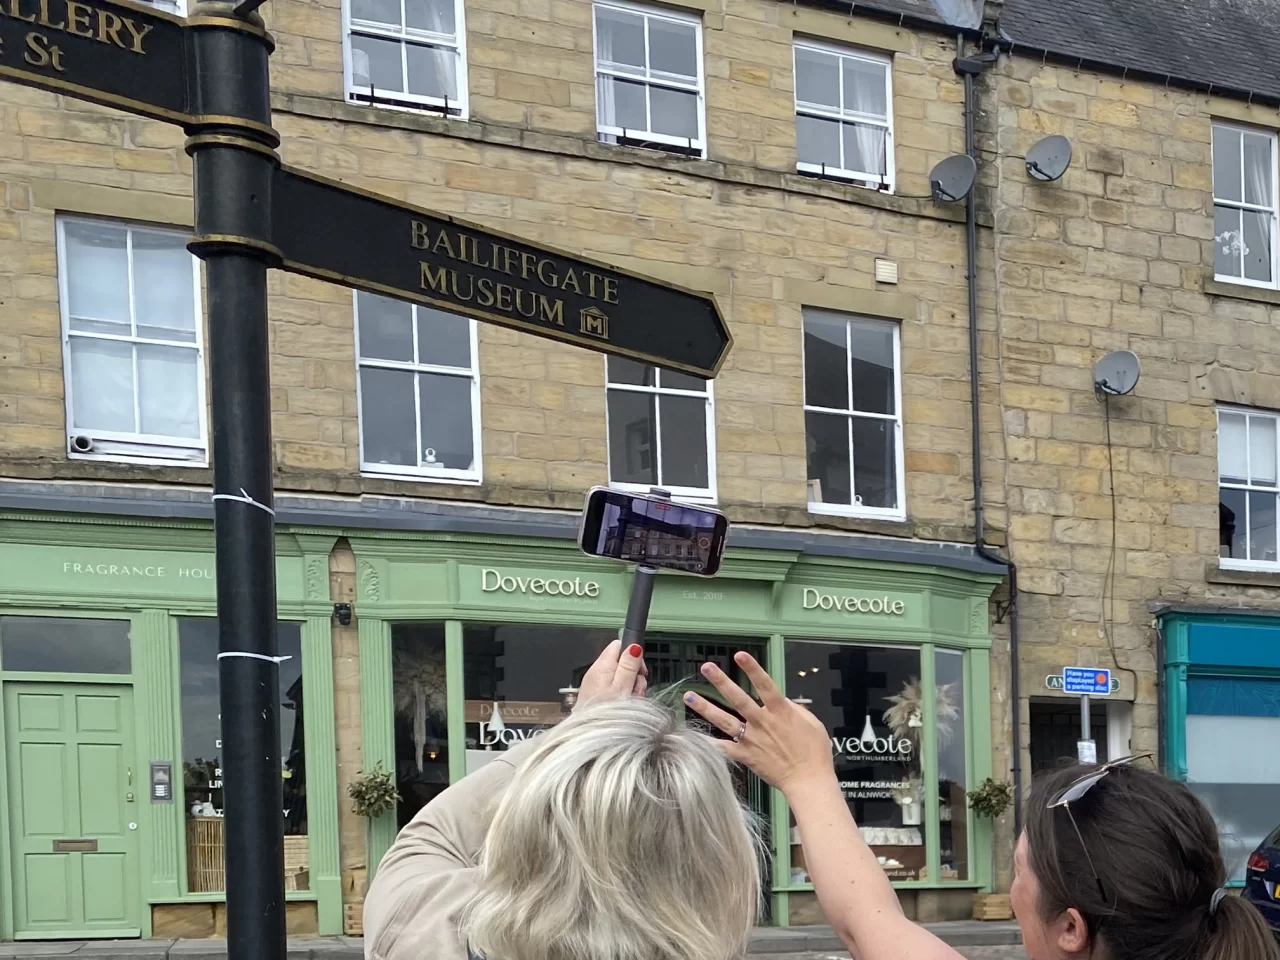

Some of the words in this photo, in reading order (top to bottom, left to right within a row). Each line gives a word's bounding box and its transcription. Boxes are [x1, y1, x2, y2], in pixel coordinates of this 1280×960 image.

[0, 0, 154, 55] LLERY
[24, 31, 66, 72] St
[410, 219, 620, 305] BAILIFFGATE
[418, 260, 565, 326] MUSEUM
[63, 562, 166, 577] FRAGRANCE
[481, 568, 600, 597] Dovecote
[802, 587, 905, 615] Dovecote
[830, 734, 912, 754] vecote
[839, 781, 860, 789] OME
[861, 781, 911, 789] FRAGRANCES
[857, 791, 892, 799] ALNWICK
